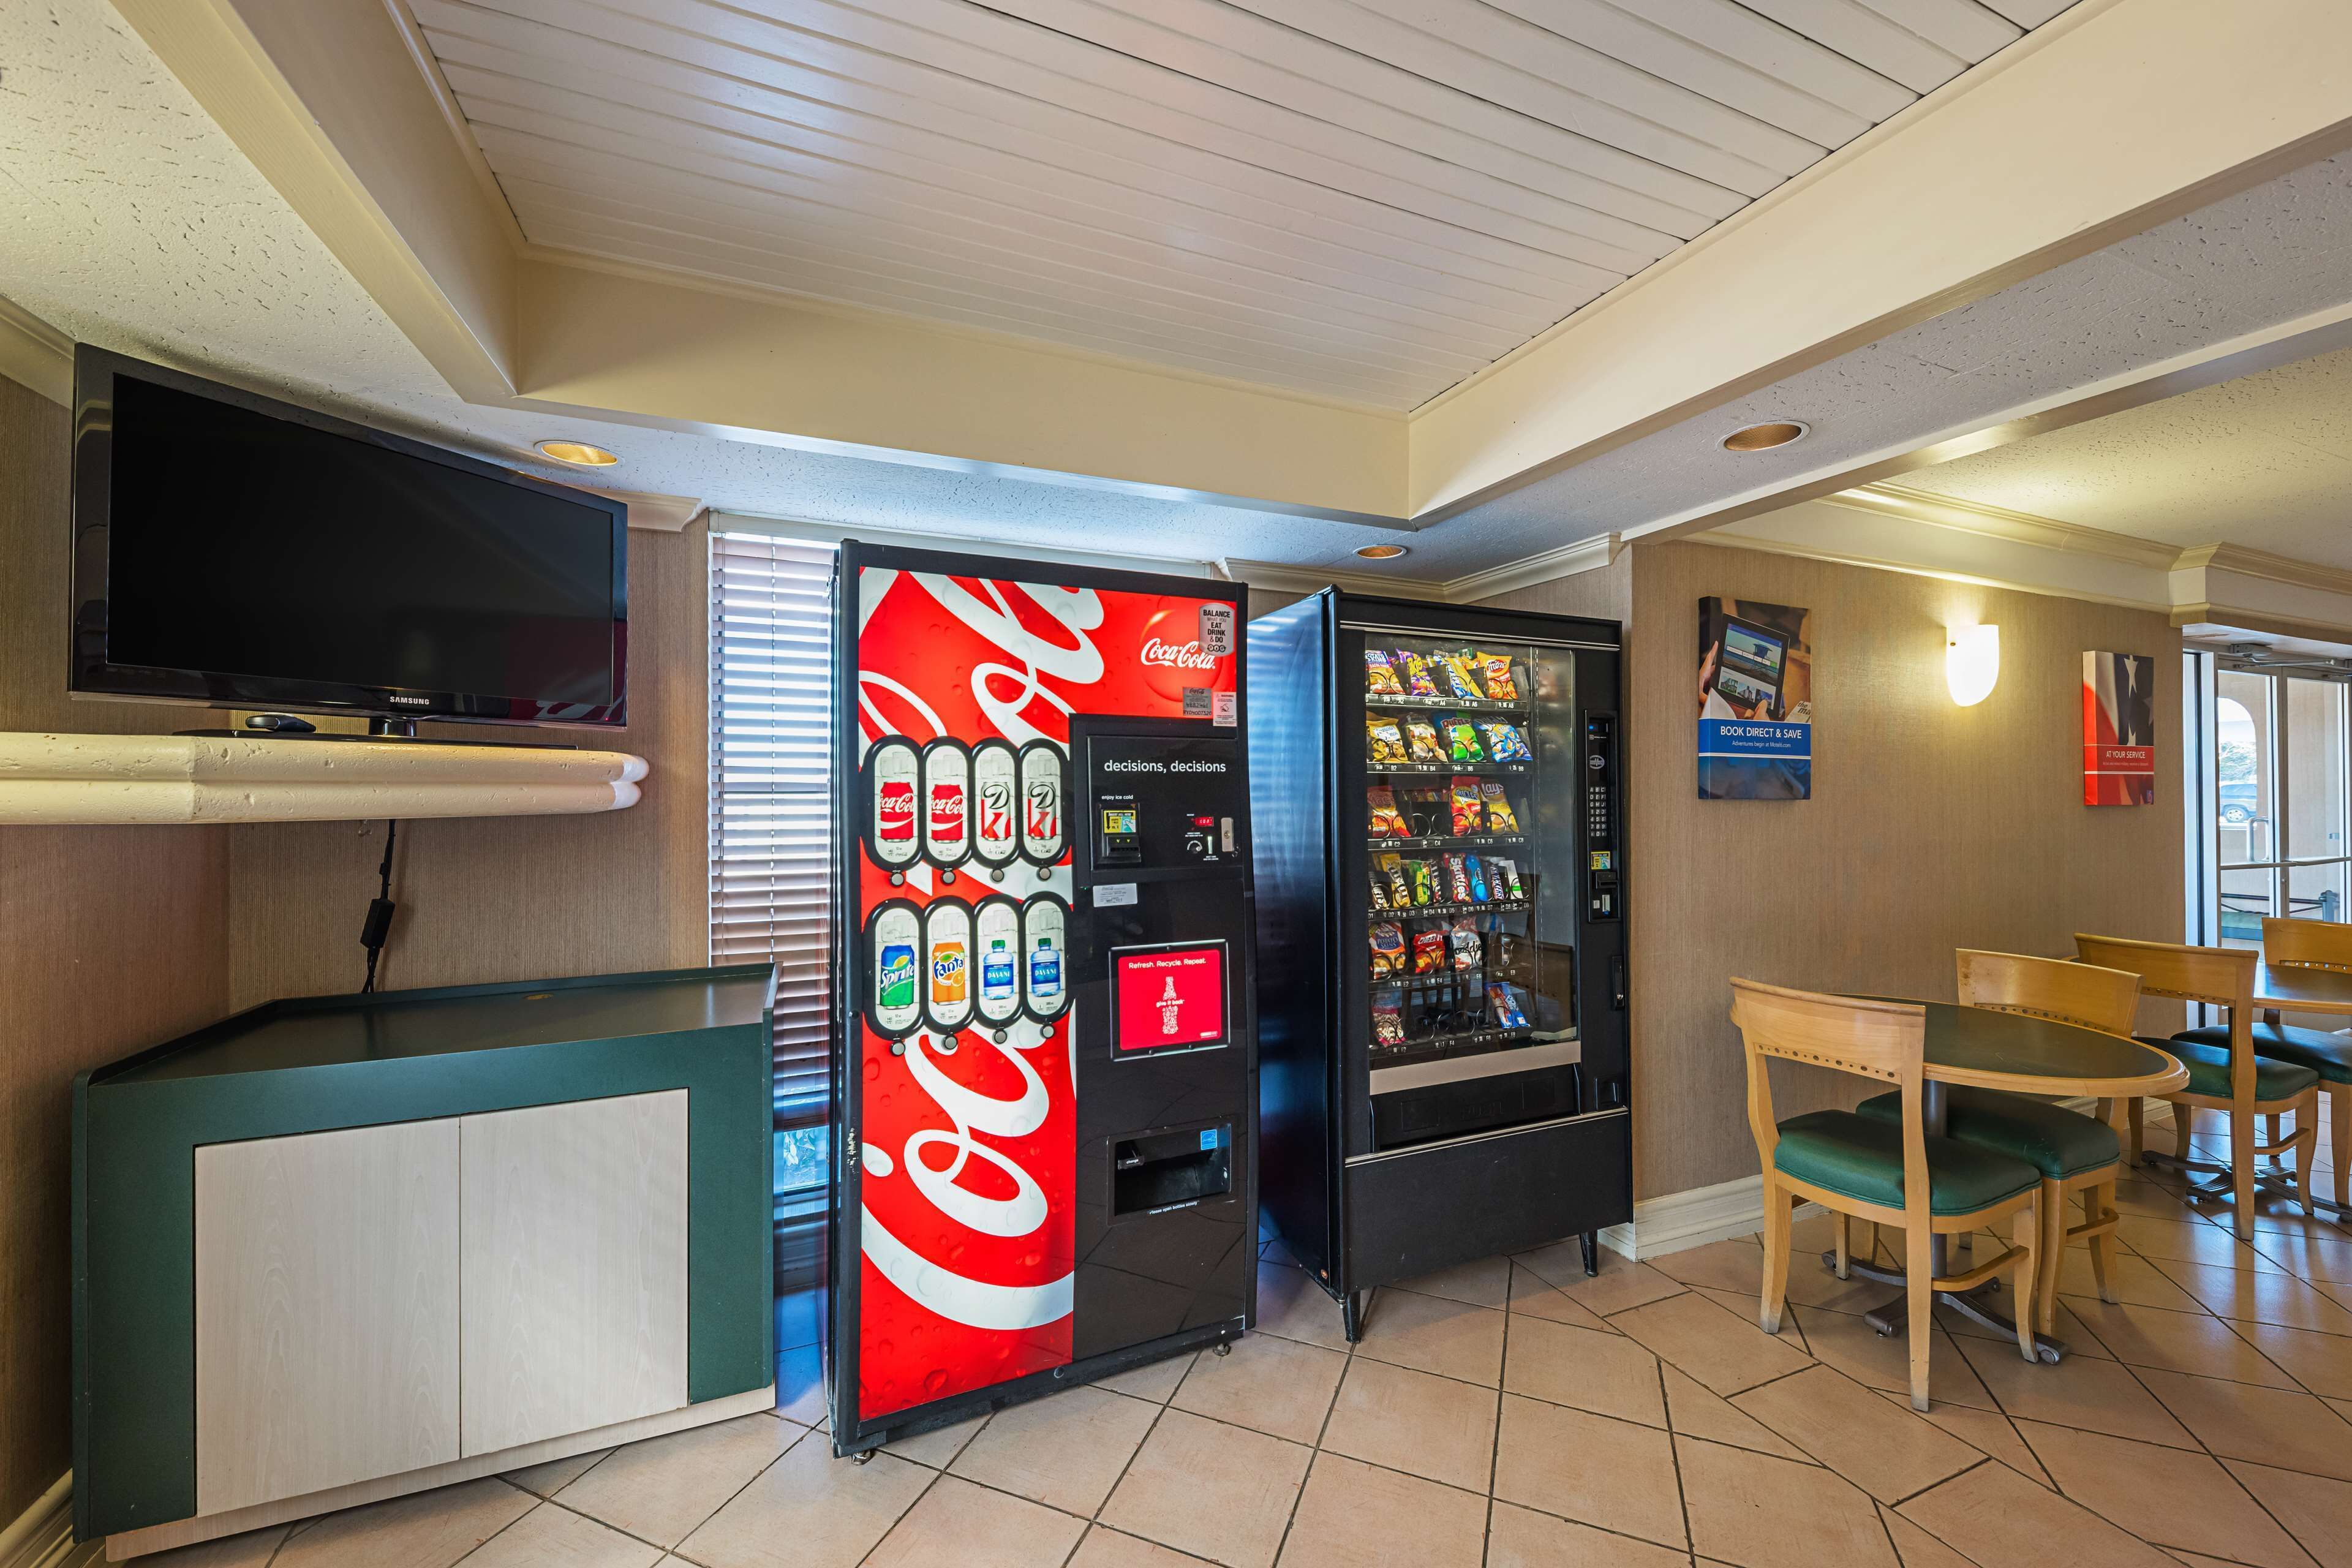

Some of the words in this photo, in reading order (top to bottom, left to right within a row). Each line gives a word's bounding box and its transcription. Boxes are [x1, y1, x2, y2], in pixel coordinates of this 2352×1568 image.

[1203, 609, 1231, 618] BALANCE
[1140, 638, 1216, 669] Coca-Cola
[390, 696, 429, 705] SAMSUNG
[1721, 726, 1744, 736] BOOK
[1747, 728, 1774, 738] DIRECT
[1776, 728, 1781, 738] &
[1784, 729, 1802, 739] SAVE
[1104, 760, 1166, 773] decisions,
[1170, 761, 1226, 772] decisions
[1450, 857, 1466, 900] Skittles
[880, 965, 914, 990] Sprite
[933, 957, 963, 980] Fanta
